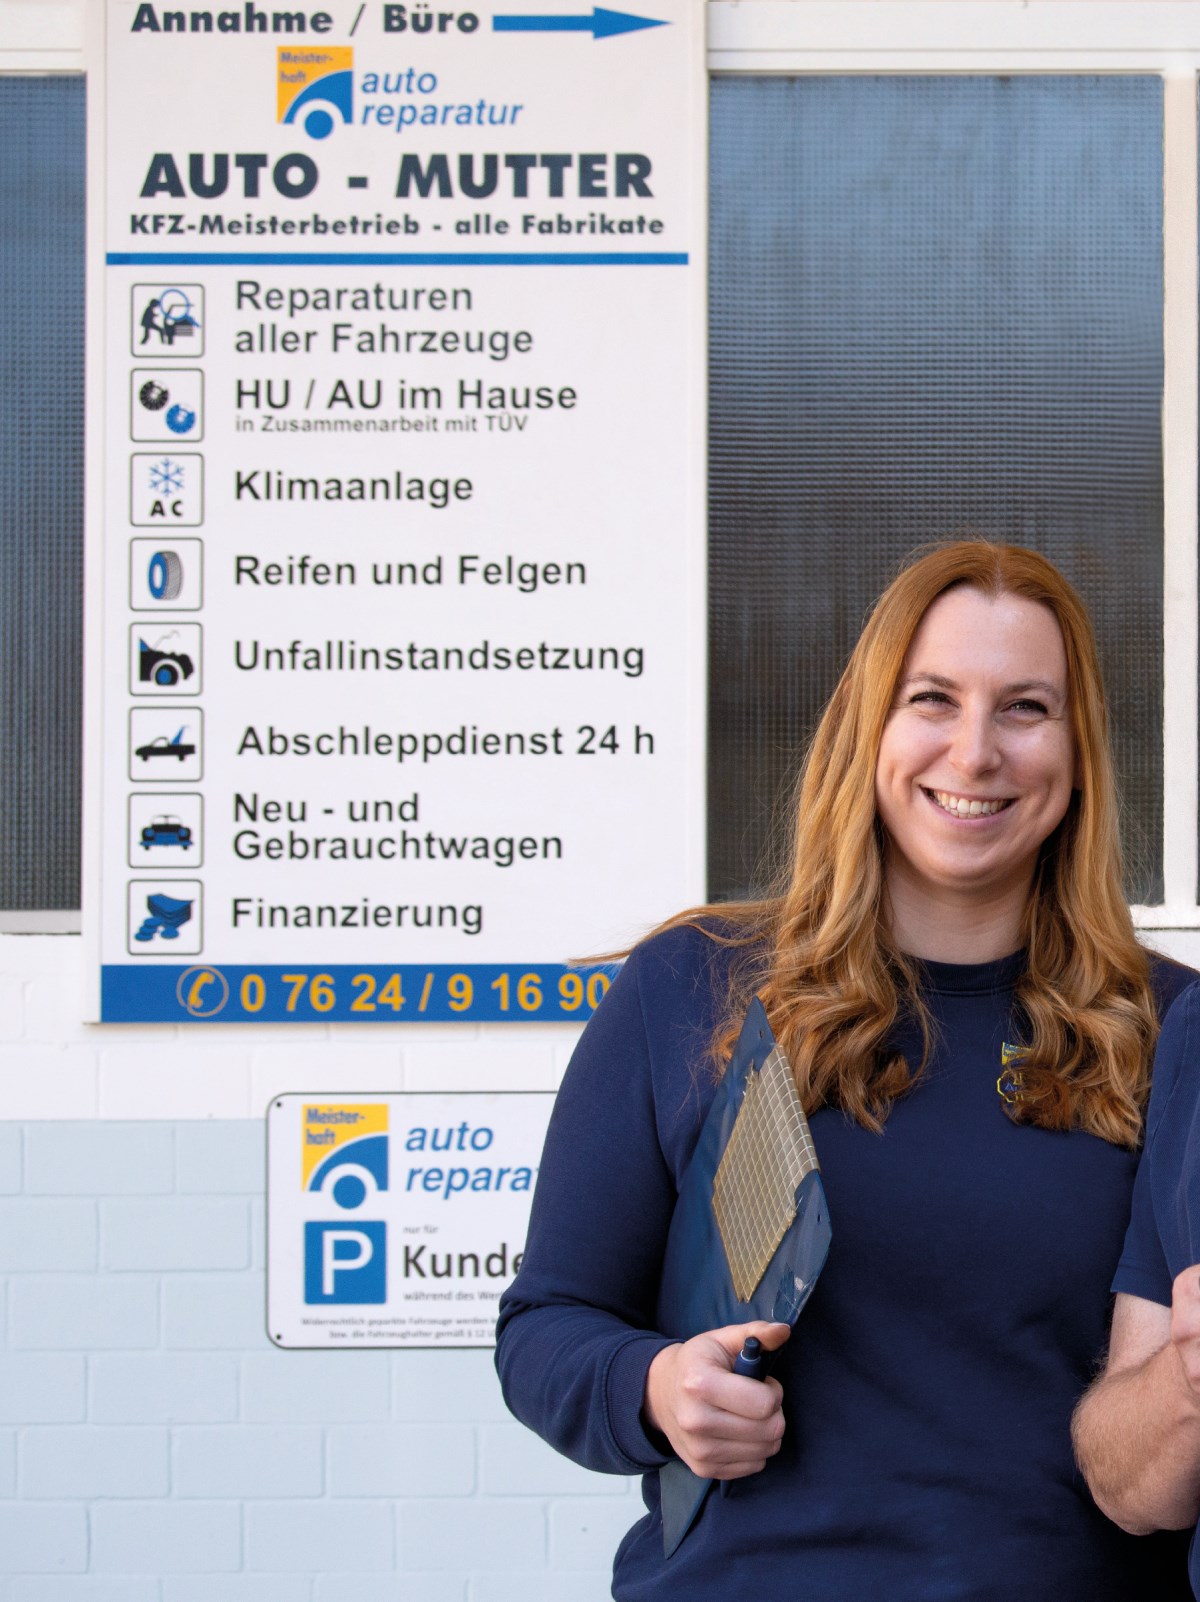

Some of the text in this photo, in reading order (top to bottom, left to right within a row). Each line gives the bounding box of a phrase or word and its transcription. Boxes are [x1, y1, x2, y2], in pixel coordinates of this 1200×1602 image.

[131, 2, 334, 34] Annahme
[384, 3, 480, 34] Büro
[361, 67, 438, 94] auto
[361, 100, 523, 133] reparatur
[140, 153, 319, 199] AUTO
[396, 153, 653, 198] MUTTER
[130, 214, 420, 235] KFZ-Meisterbetrieb
[455, 213, 509, 235] alle
[522, 213, 664, 235] Fabrikate
[236, 281, 472, 317] Reparaturen
[235, 323, 533, 361] aller Fahrzeuge
[237, 380, 290, 409] HU
[327, 380, 382, 409] AU
[400, 380, 441, 409] im
[458, 380, 577, 409] Hause
[236, 413, 528, 432] in Zusammenarbeit mit TÜV
[235, 471, 474, 508] Klimaanlage
[235, 555, 586, 593] Reifen und Felgen
[234, 640, 644, 677] Unfallinstandsetzung
[237, 725, 654, 763] Abschleppdienst 24 h
[233, 793, 307, 822] Neu
[348, 793, 419, 822] und
[232, 830, 562, 867] Gebrauchtwagen
[232, 898, 483, 935] Finanzierung
[240, 973, 266, 1012] 0
[281, 974, 336, 1012] 76
[350, 973, 406, 1012] 24
[447, 973, 474, 1012] 9
[490, 973, 543, 1012] 16
[306, 1109, 366, 1124] Meister-
[305, 1129, 336, 1145] haft
[405, 1122, 494, 1152] auto
[406, 1166, 540, 1200] repara
[323, 1230, 373, 1295] P
[477, 1290, 503, 1301] Wer
